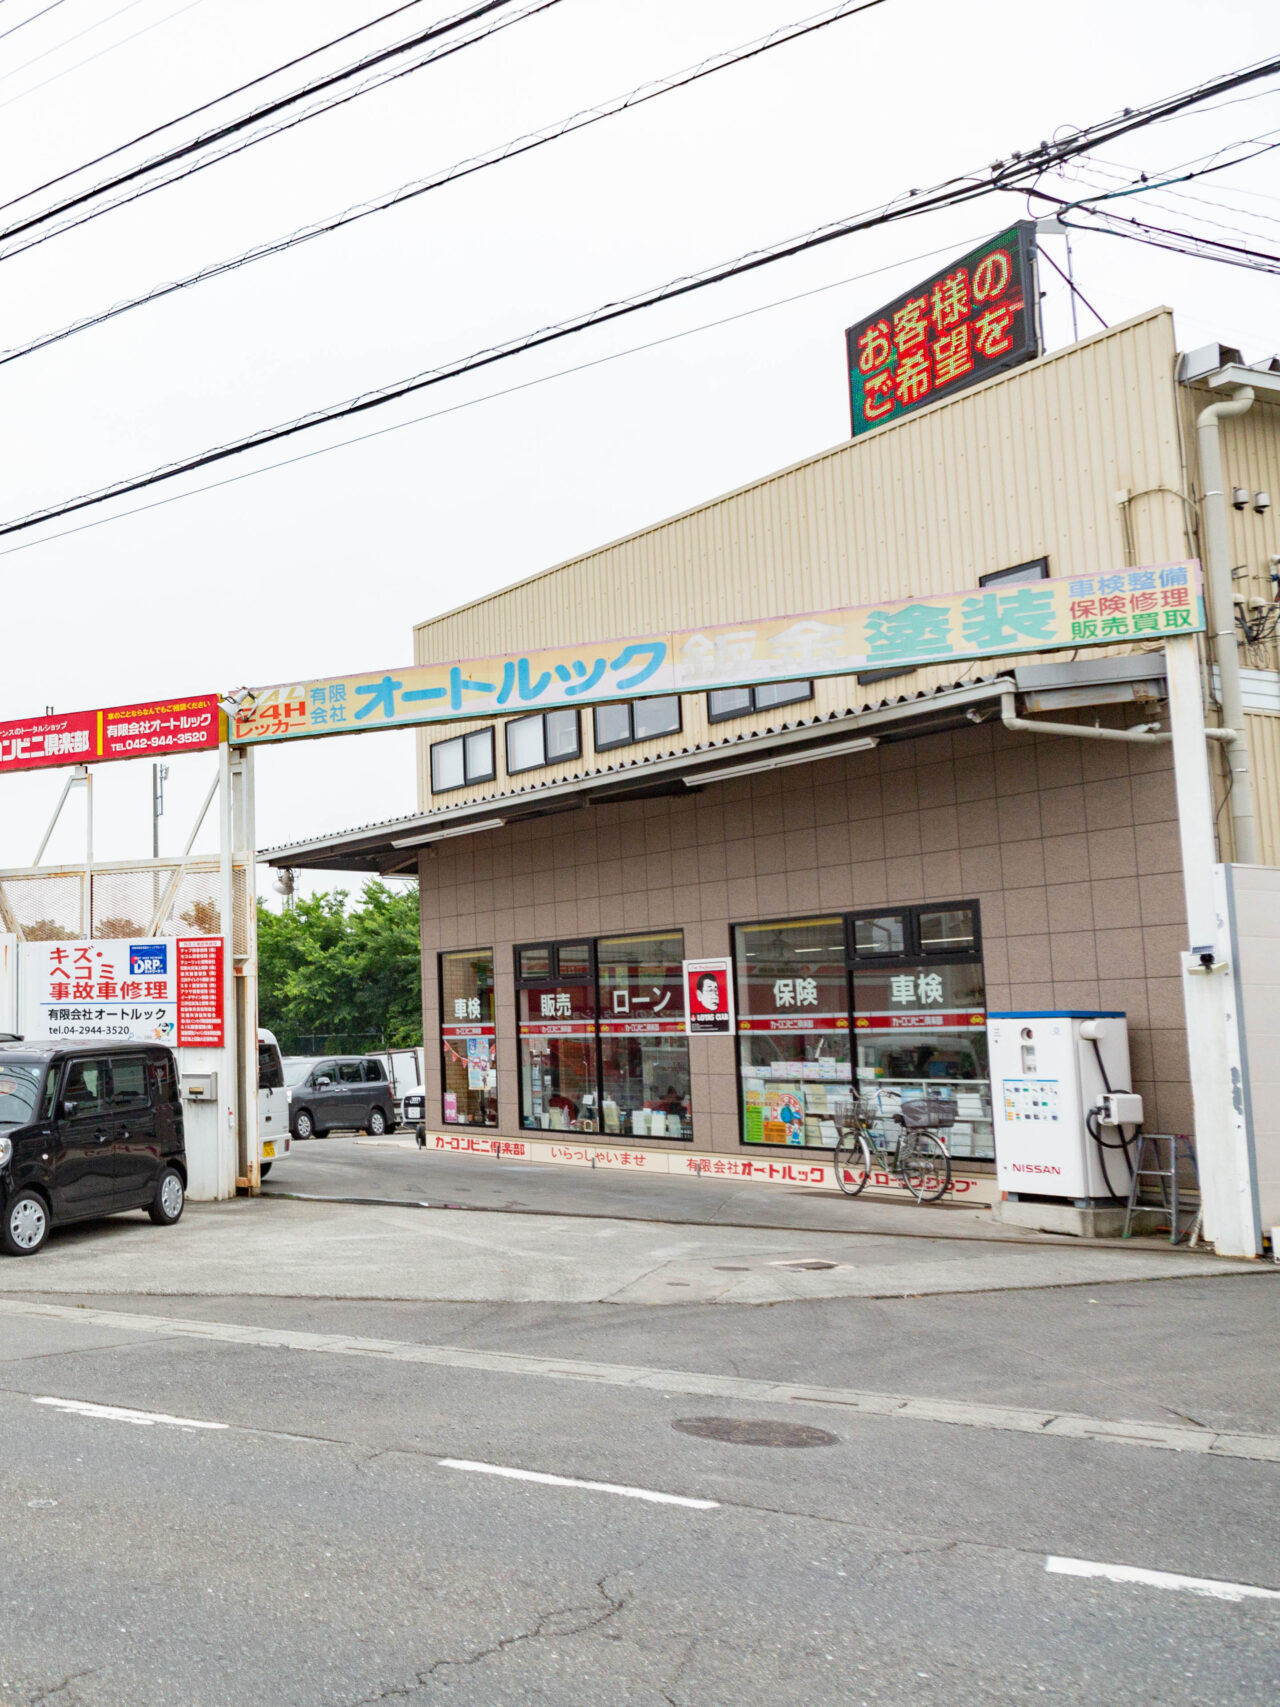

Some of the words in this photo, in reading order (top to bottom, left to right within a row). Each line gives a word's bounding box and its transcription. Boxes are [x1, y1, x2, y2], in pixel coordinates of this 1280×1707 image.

[858, 249, 1012, 375] お客様の
[863, 302, 1013, 421] ご希望を
[1068, 566, 1188, 600] 車検整備
[1069, 587, 1191, 621] 保険修理
[1070, 608, 1193, 640] 販売買取
[354, 641, 668, 720] オートルック
[310, 683, 347, 705] 有限
[107, 701, 211, 720] 車のことならなんでもご相談ください
[236, 701, 306, 724] 24H
[310, 704, 347, 725] 会社
[107, 713, 211, 738] 有限会社オートルック
[235, 719, 307, 739] レッカー
[49, 963, 115, 981] ヘコミ
[134, 959, 160, 974] DRP
[49, 981, 168, 1001] 事故車修理
[612, 986, 671, 1014] ローン
[773, 977, 819, 1008] 保険
[890, 973, 944, 1005] 車検
[48, 1007, 167, 1021] 有限会社オートルック
[454, 998, 481, 1019] 車検
[540, 993, 571, 1017] 販売
[48, 1025, 130, 1036] tel.04-2944-3520
[435, 1136, 525, 1156] カーコンビニ倶楽部
[551, 1146, 647, 1166] いらっしゃいませ
[686, 1157, 825, 1183] 有限会社オートルック
[1012, 1163, 1061, 1175] NISSAN
